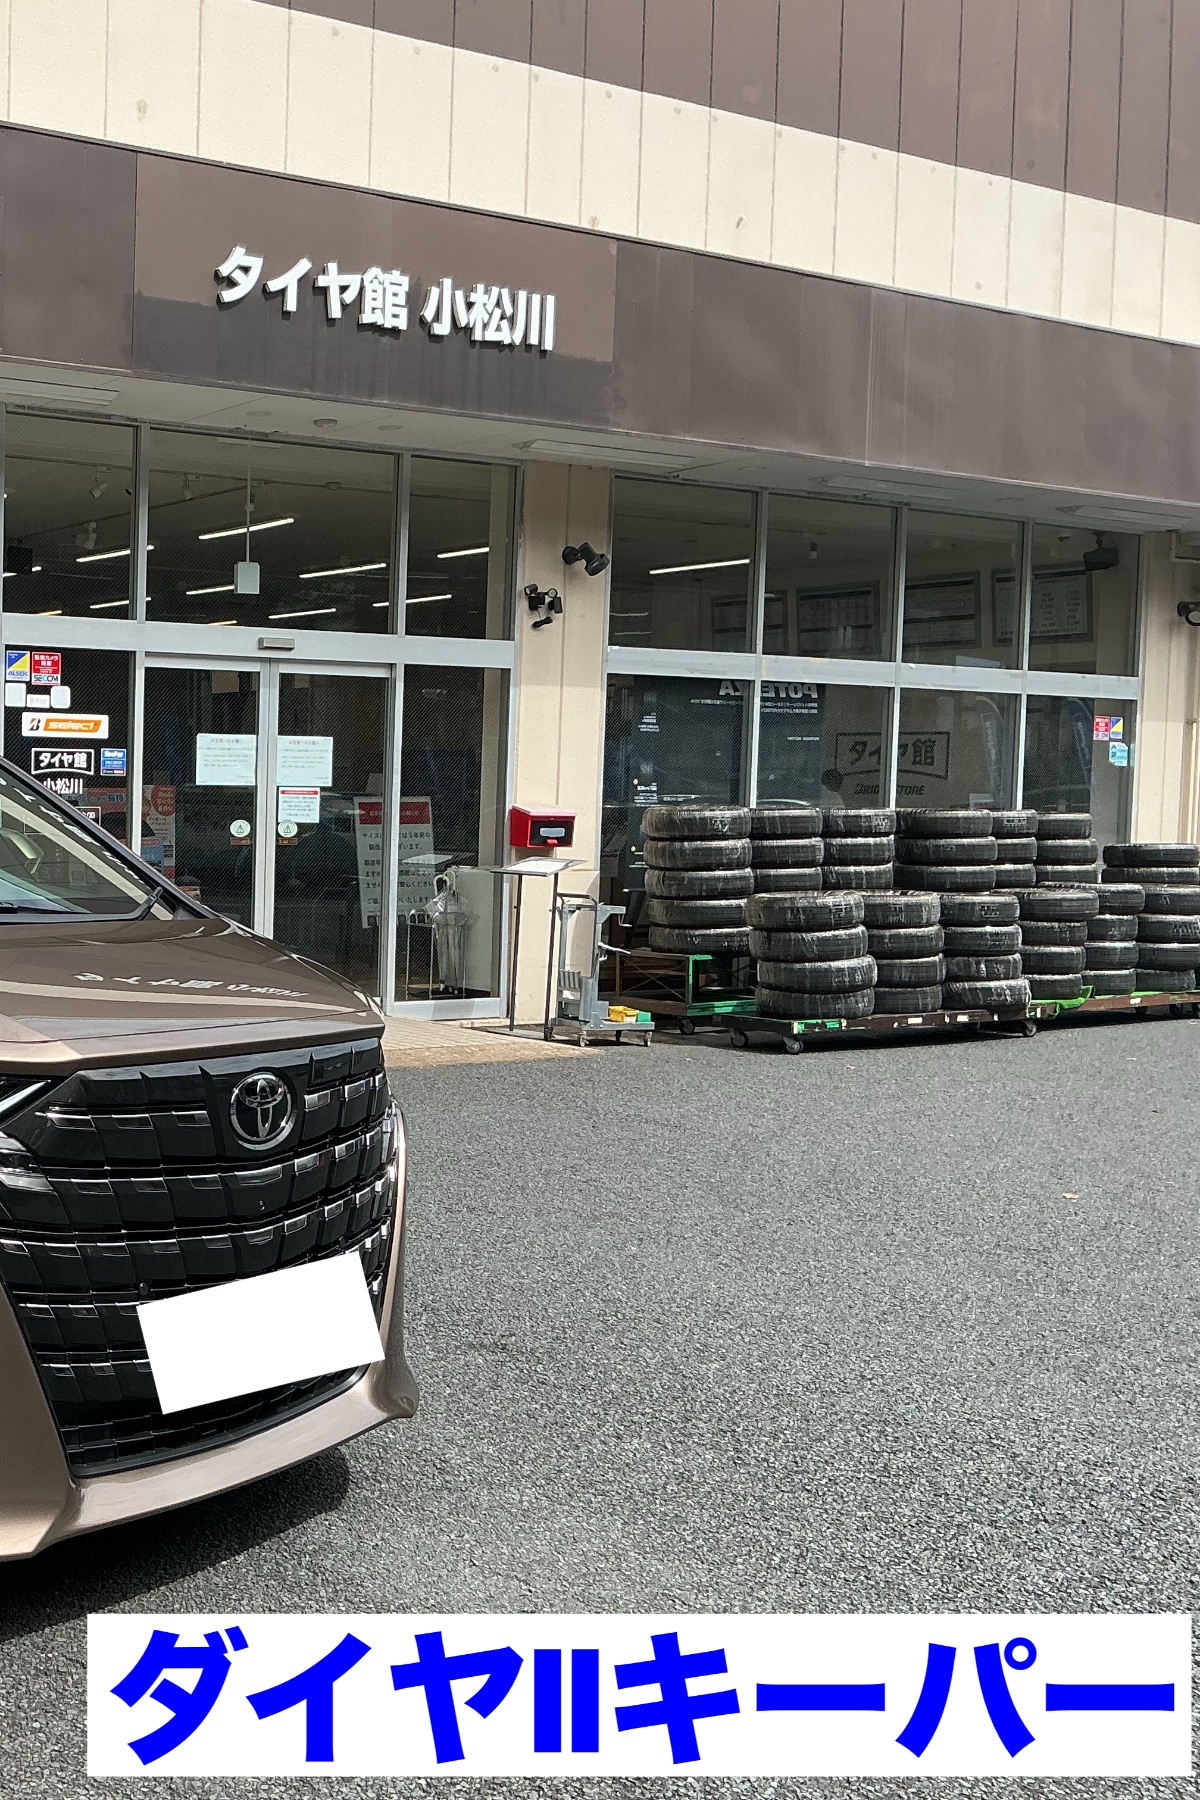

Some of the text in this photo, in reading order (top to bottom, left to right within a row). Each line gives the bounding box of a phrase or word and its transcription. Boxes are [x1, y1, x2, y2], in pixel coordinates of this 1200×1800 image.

[213, 244, 555, 351] タイヤ館 小松川
[33, 674, 59, 682] SECOM
[48, 720, 99, 731] select
[39, 752, 88, 768] タイヤ館
